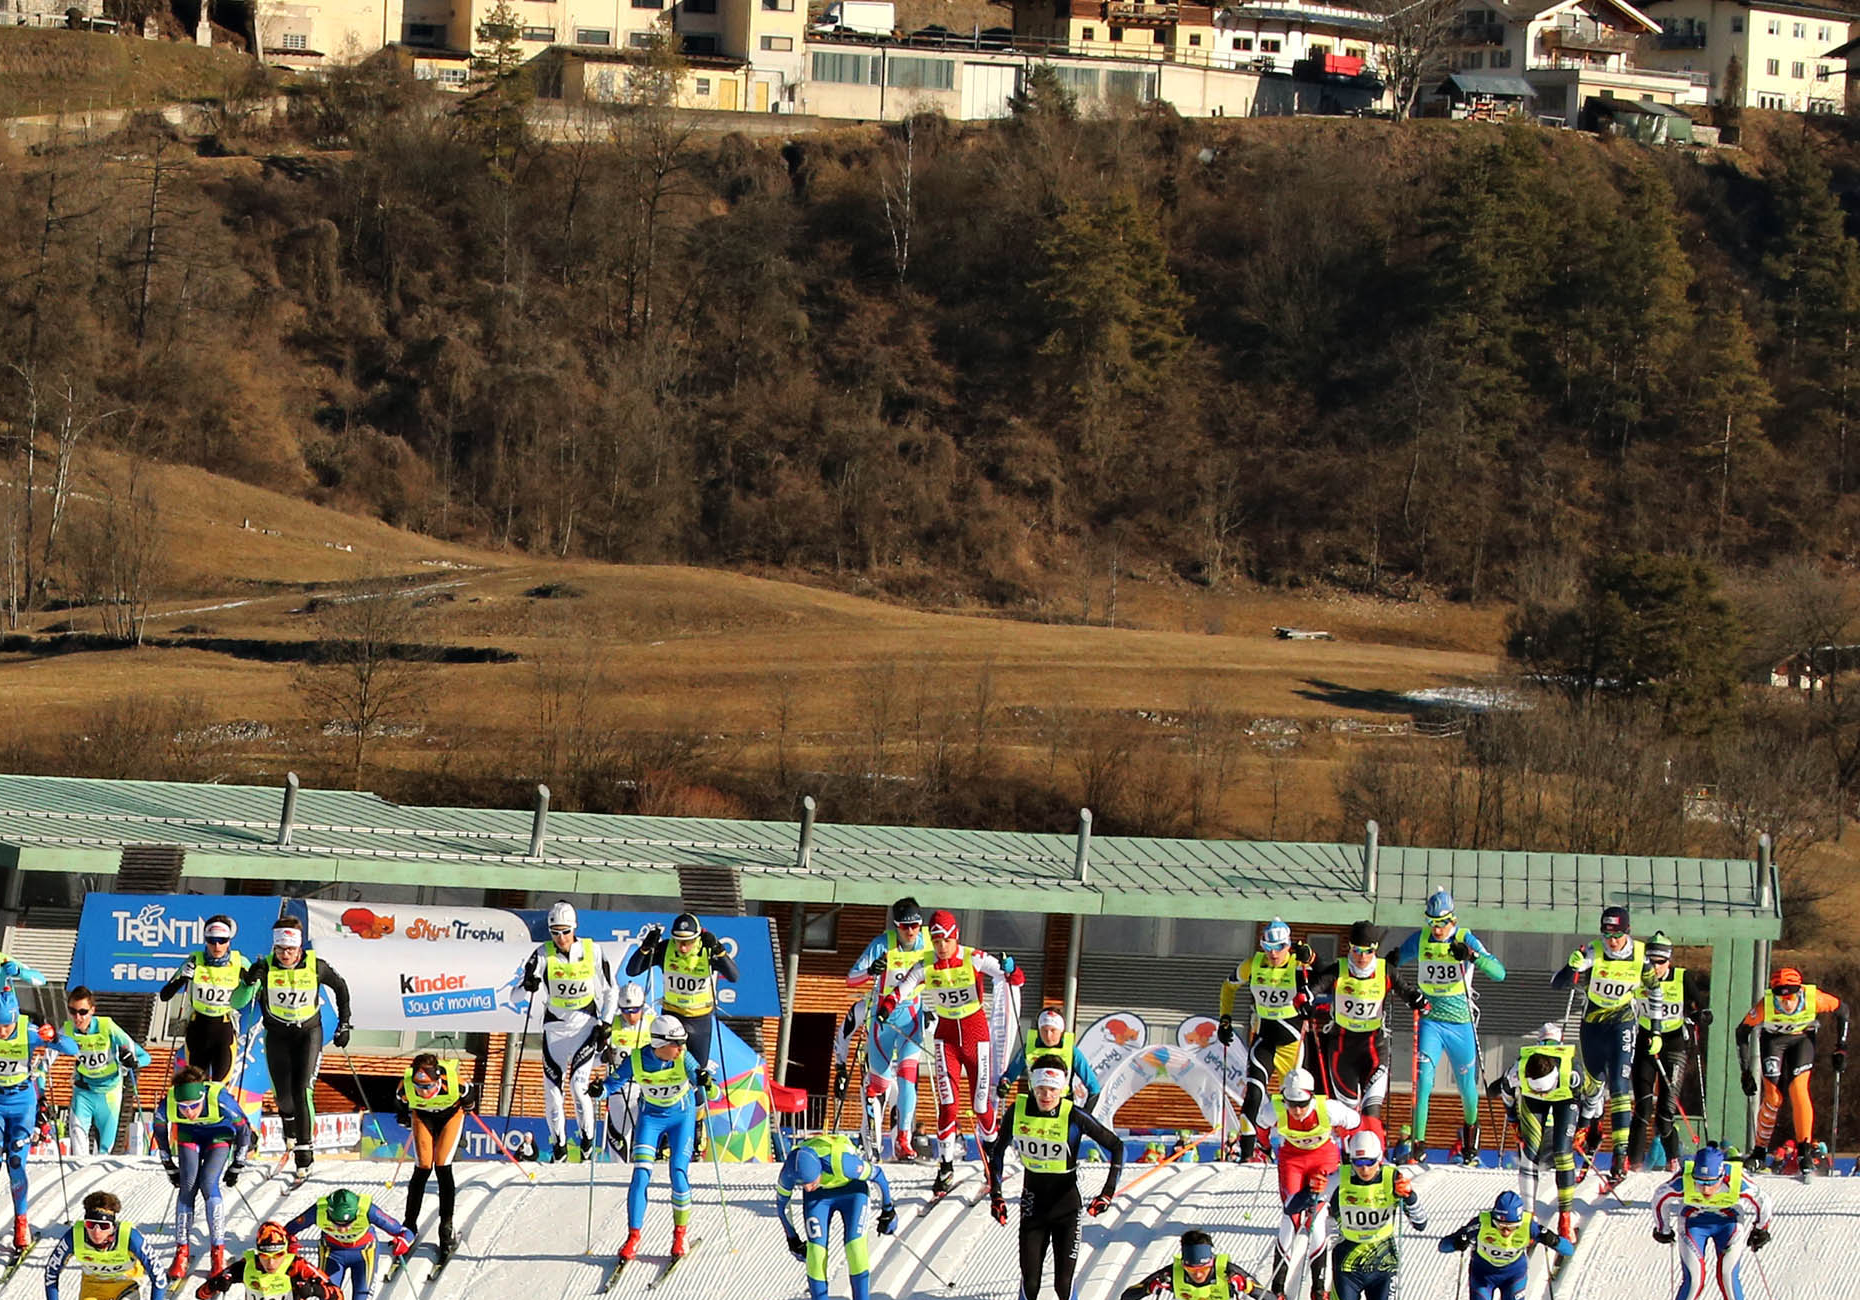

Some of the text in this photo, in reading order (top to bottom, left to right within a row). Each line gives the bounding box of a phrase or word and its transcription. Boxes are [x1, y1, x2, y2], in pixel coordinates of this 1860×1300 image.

[405, 917, 505, 943] Skiri Trophy
[1427, 965, 1457, 979] 938
[556, 983, 588, 995] 964
[667, 975, 706, 991] 1002
[277, 992, 308, 1005] 974
[407, 992, 492, 1015] Joy of moving
[937, 989, 969, 1004] 955
[1258, 990, 1289, 1003] 969
[1344, 1000, 1376, 1014] 937
[979, 1055, 988, 1090] Fibank
[648, 1085, 680, 1098] 973
[1020, 1140, 1062, 1156] 1019
[1344, 1209, 1389, 1226] 1004
